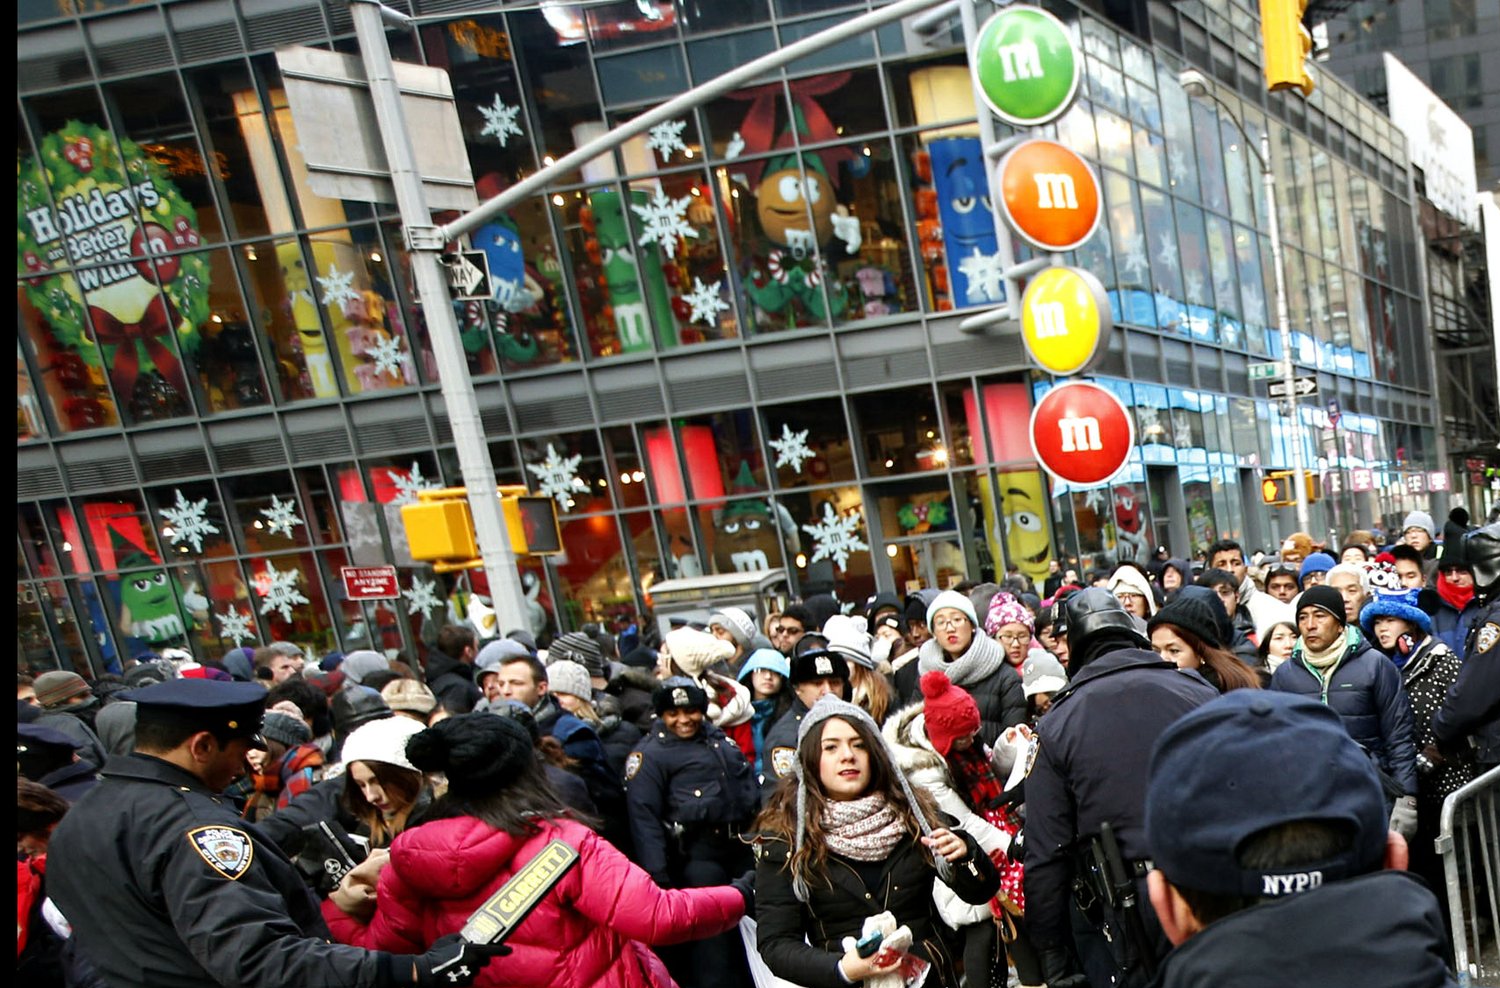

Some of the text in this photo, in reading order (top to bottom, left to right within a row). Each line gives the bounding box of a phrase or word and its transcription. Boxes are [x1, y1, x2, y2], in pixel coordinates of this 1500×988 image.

[999, 39, 1044, 82] m
[1033, 173, 1079, 209] m
[27, 181, 159, 244] Holidays
[66, 225, 128, 261] Better
[77, 249, 138, 291] with
[1031, 301, 1069, 339] m
[1058, 416, 1103, 452] m
[499, 847, 567, 913] GARRETT
[1261, 870, 1323, 896] NYPD
